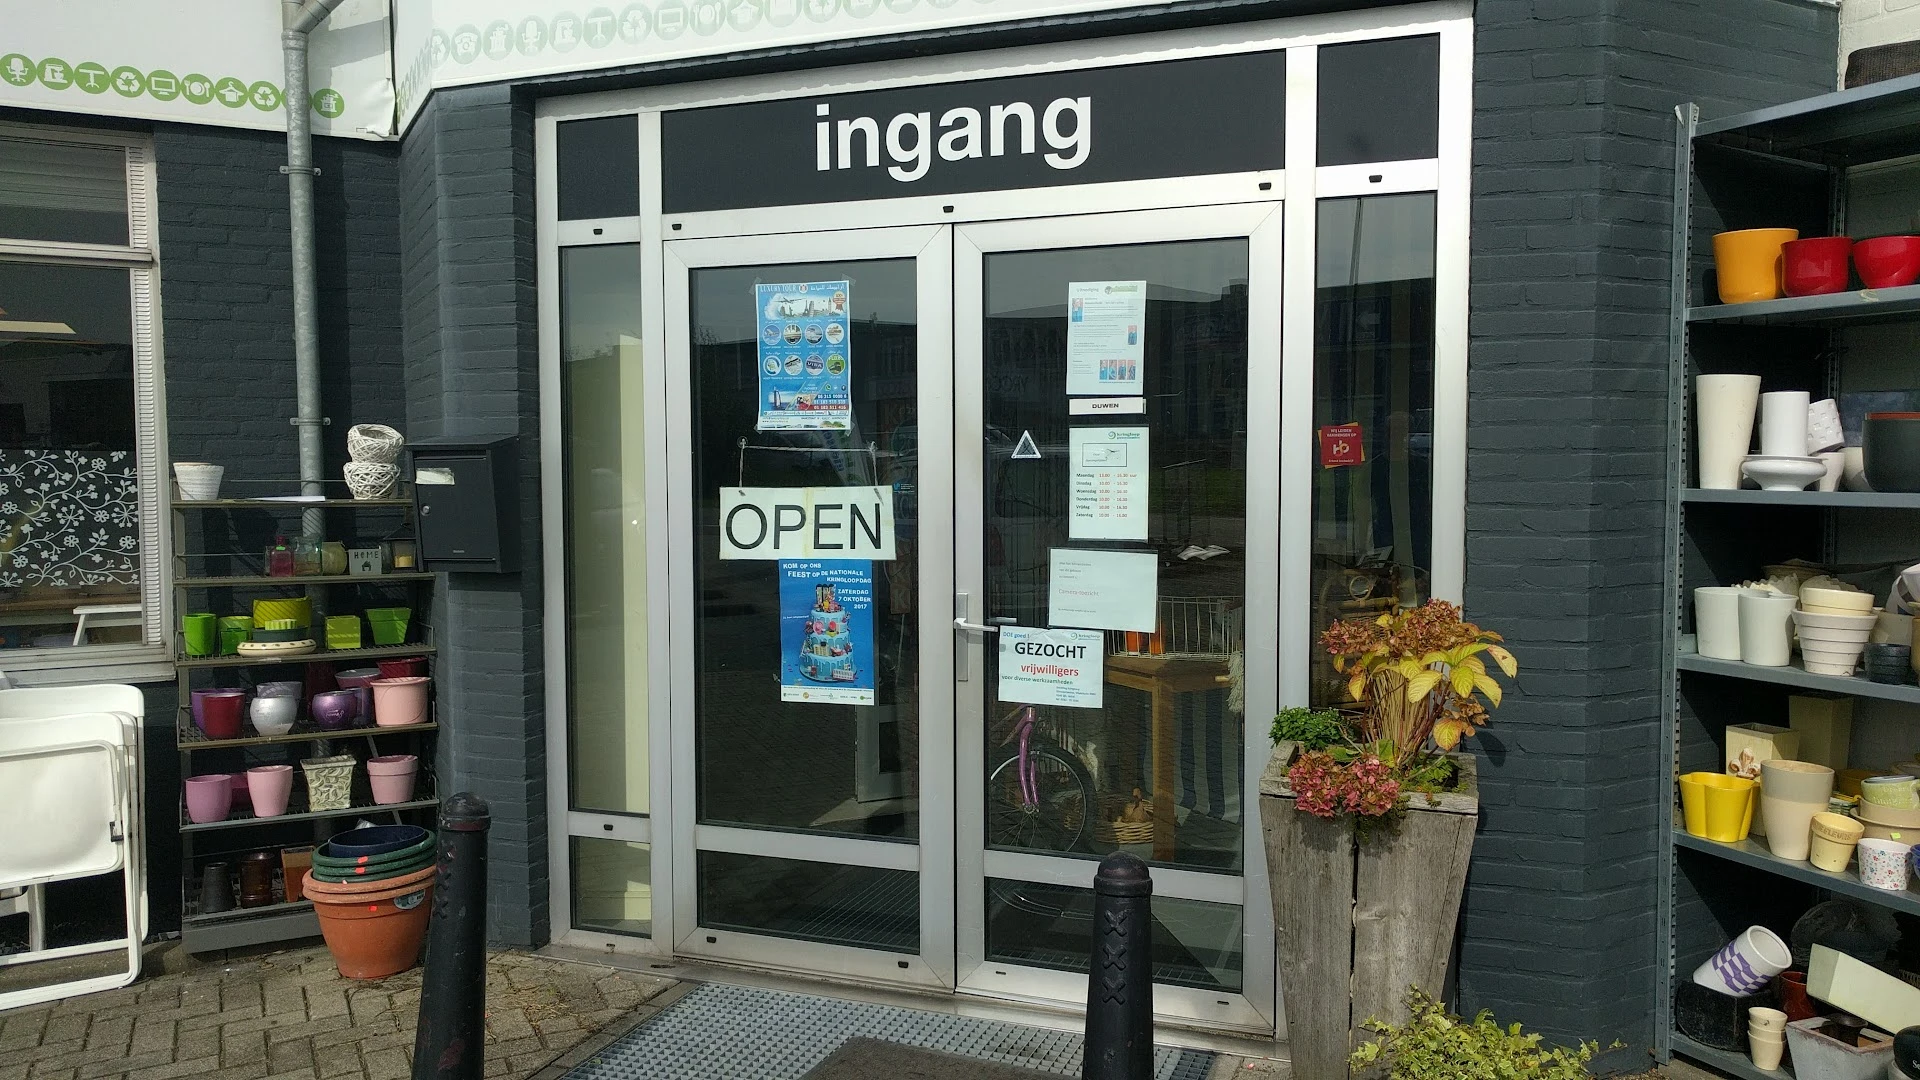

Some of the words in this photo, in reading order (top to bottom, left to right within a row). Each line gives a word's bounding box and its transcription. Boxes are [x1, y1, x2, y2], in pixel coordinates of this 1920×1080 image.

[817, 96, 1091, 182] ingang
[726, 504, 881, 549] OPEN
[1015, 642, 1086, 658] GEZOCHT
[1021, 664, 1079, 677] vrijwilligers
